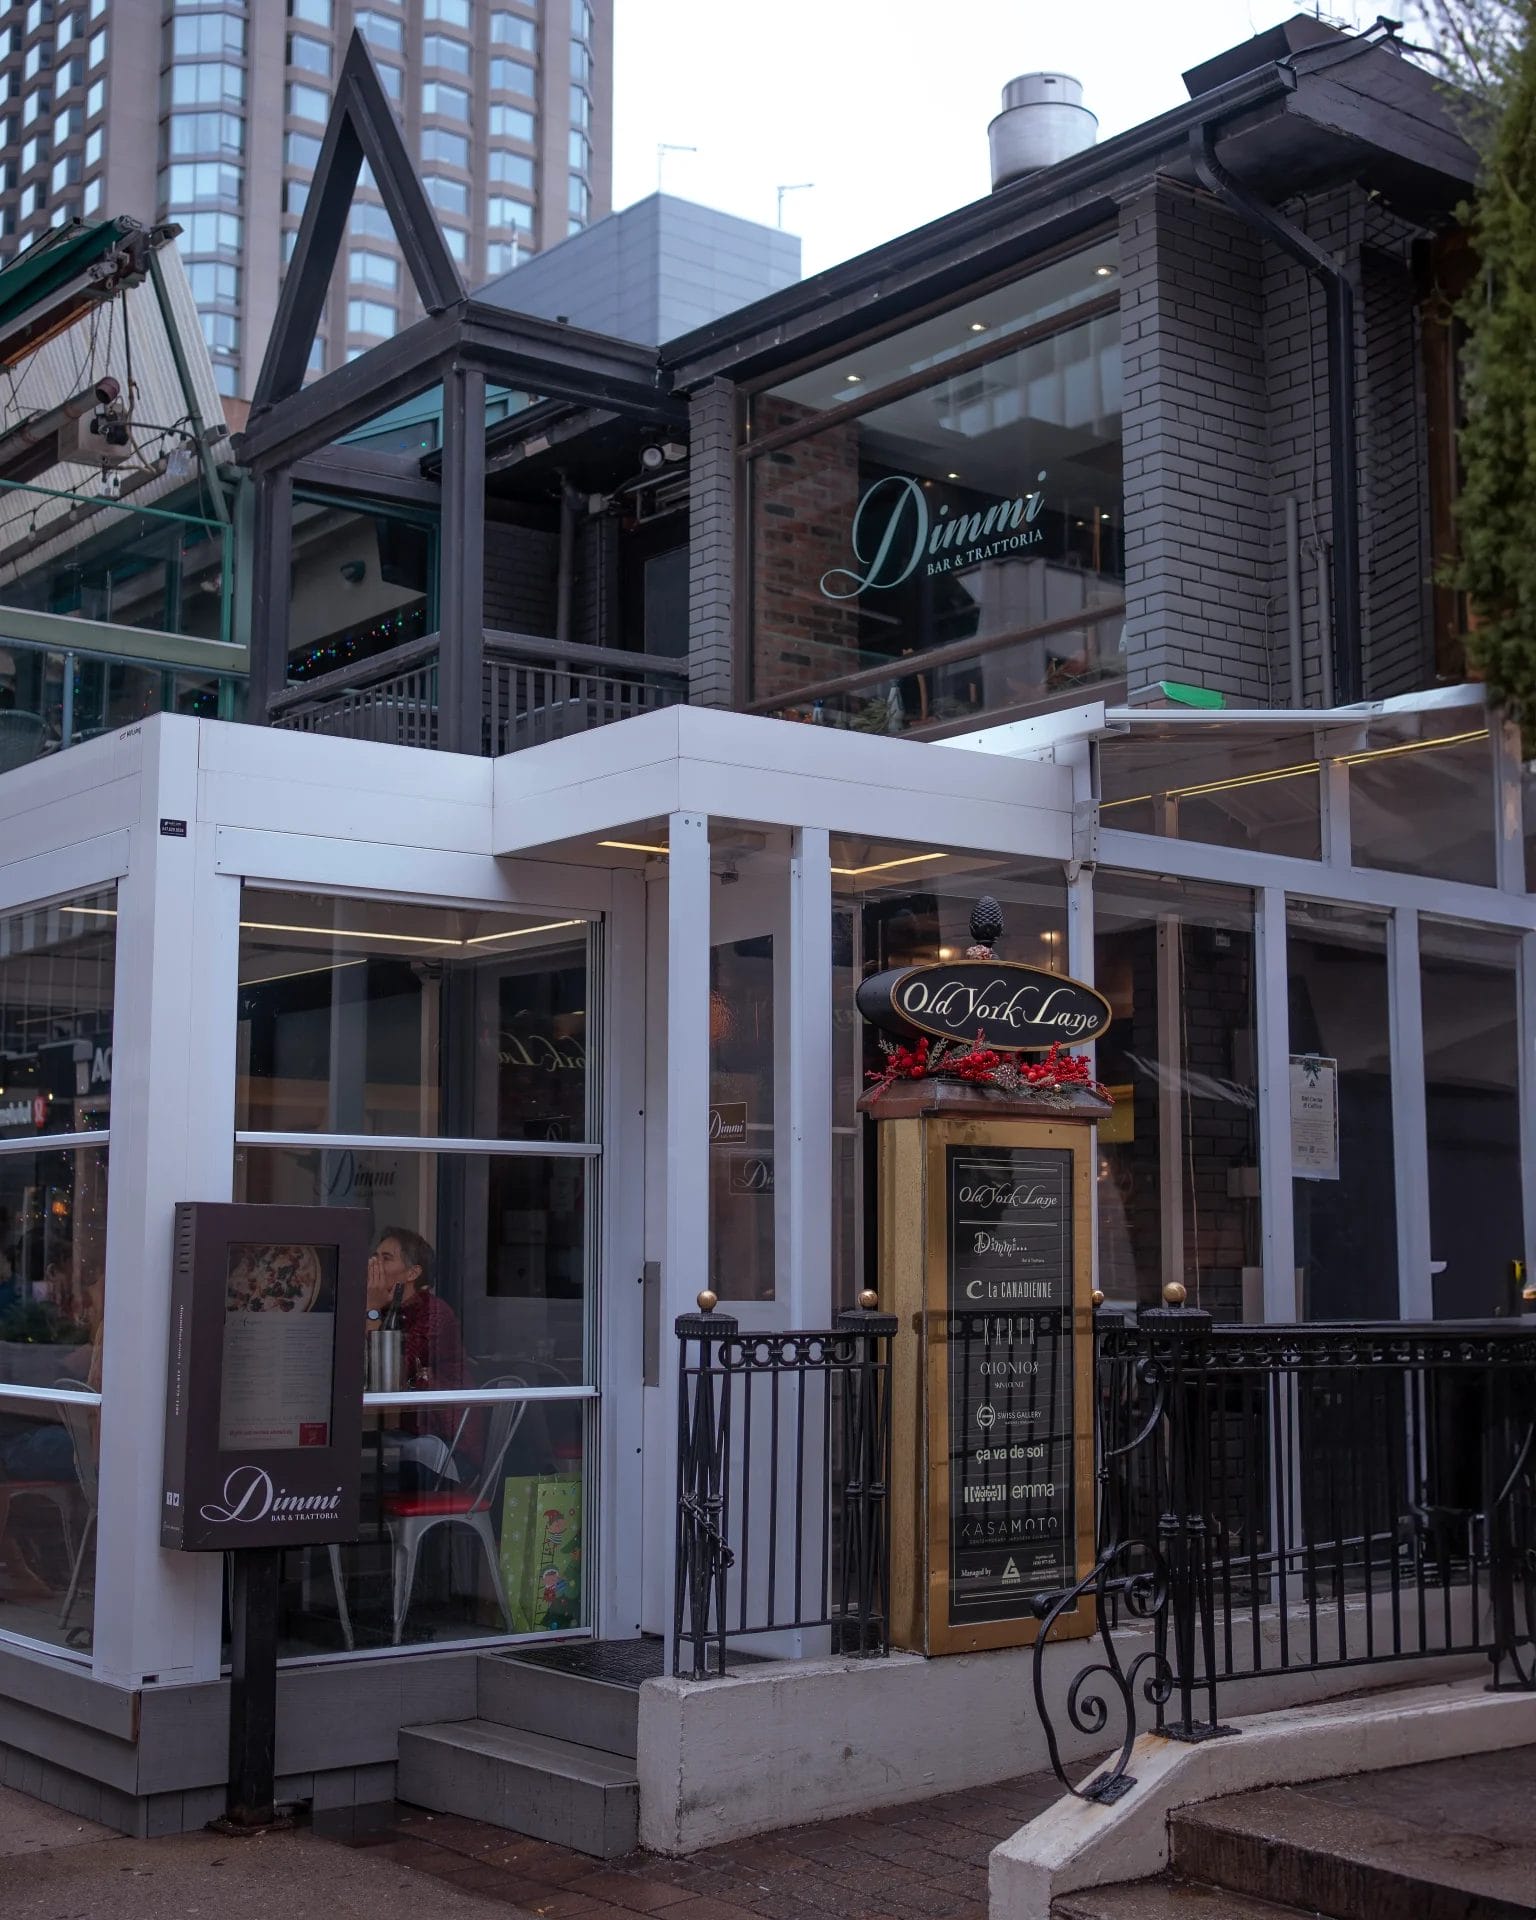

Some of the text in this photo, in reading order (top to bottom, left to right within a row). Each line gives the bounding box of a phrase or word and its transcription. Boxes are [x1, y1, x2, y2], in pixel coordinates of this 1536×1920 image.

[819, 470, 1047, 599] Dimmi
[927, 528, 1044, 576] BAR & TRATTORIA
[903, 979, 1099, 1036] Old York Lane
[959, 1183, 1057, 1209] Old York Lane
[988, 1282, 998, 1298] La
[1001, 1282, 1052, 1298] CANADIENNE
[984, 1318, 1035, 1345] KARIR
[997, 1412, 1015, 1420] SWISS
[1016, 1411, 1042, 1419] GALLERY
[976, 1443, 1044, 1464] ça va de soi
[200, 1466, 342, 1522] Dimmi
[1012, 1483, 1055, 1499] emma
[295, 1513, 338, 1521] TRATTORIA
